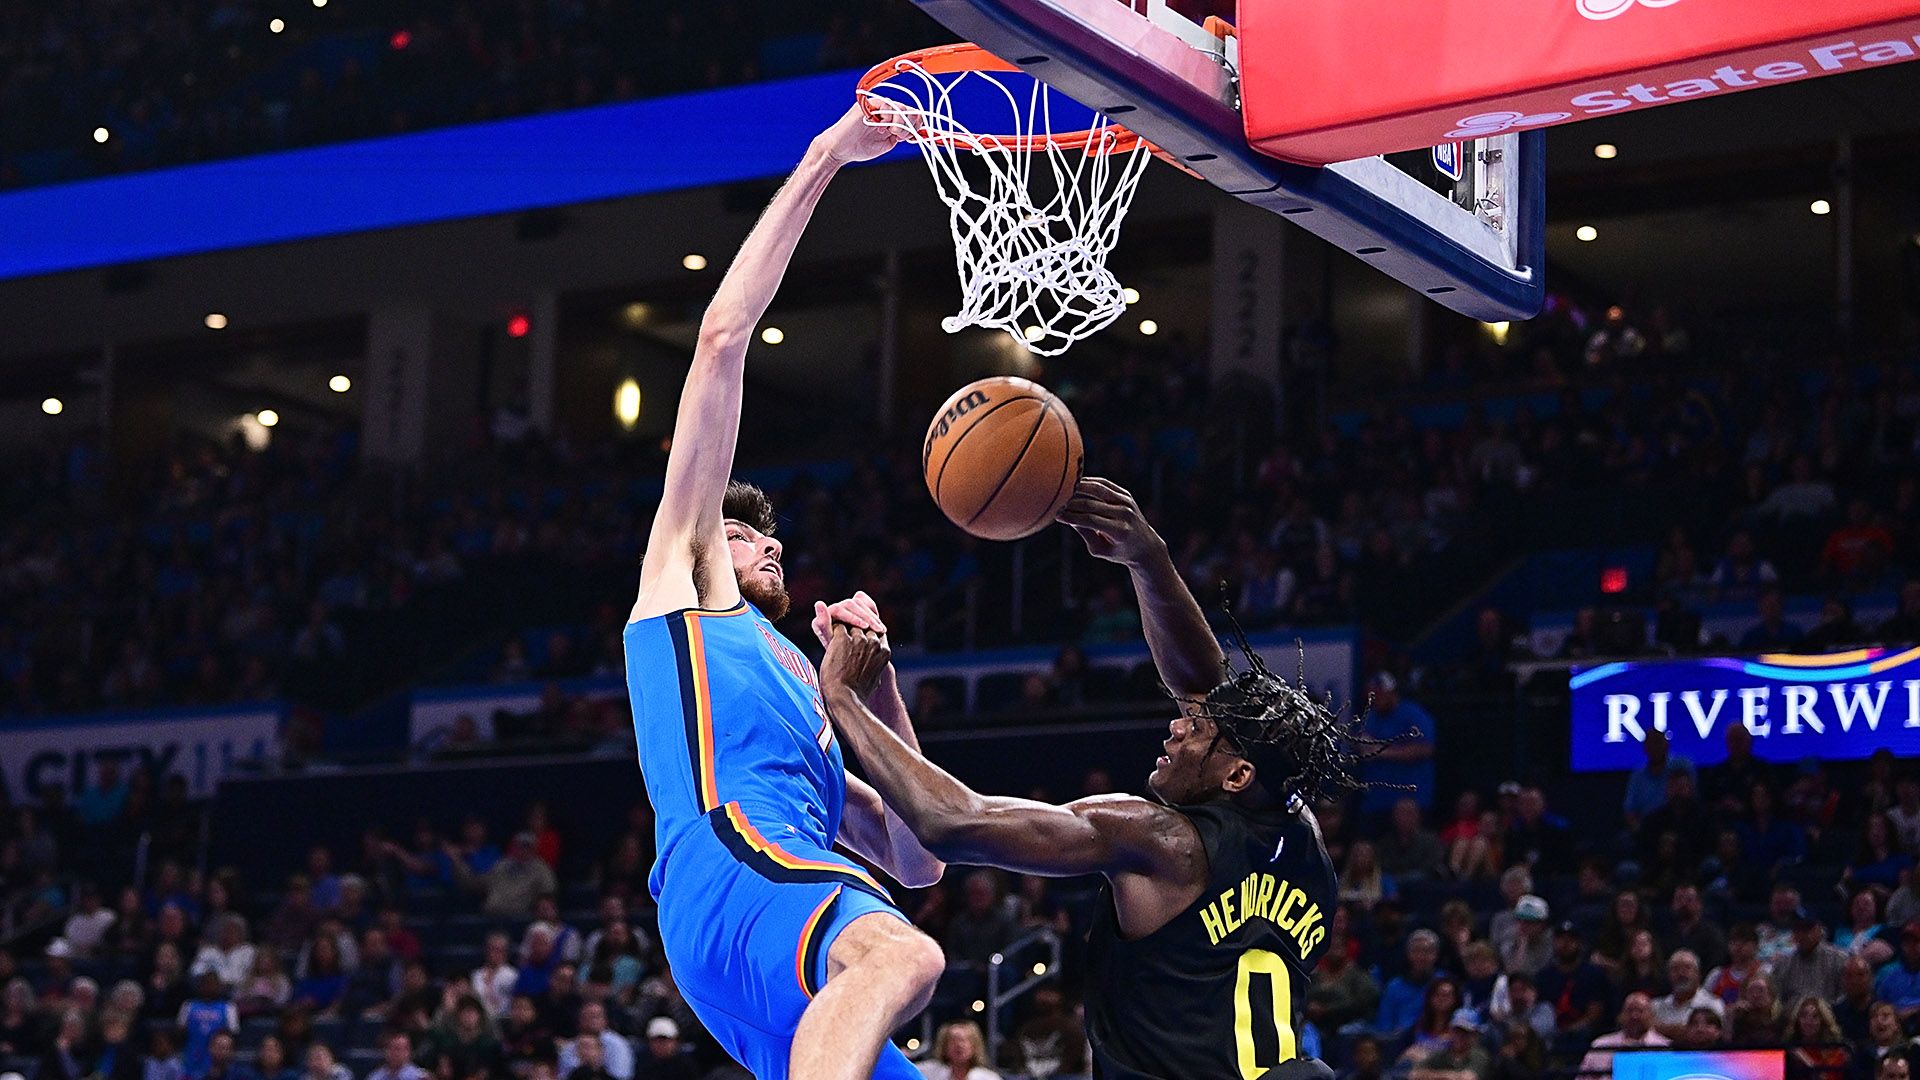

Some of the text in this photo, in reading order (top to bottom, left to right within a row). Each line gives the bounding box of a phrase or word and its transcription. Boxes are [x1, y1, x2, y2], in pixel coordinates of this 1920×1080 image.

[1570, 33, 1920, 114] State Fa
[1437, 142, 1452, 167] NBA
[1602, 679, 1920, 743] RIVERWI
[1199, 872, 1326, 960] HENDRICKS
[1233, 947, 1297, 1080] 0
